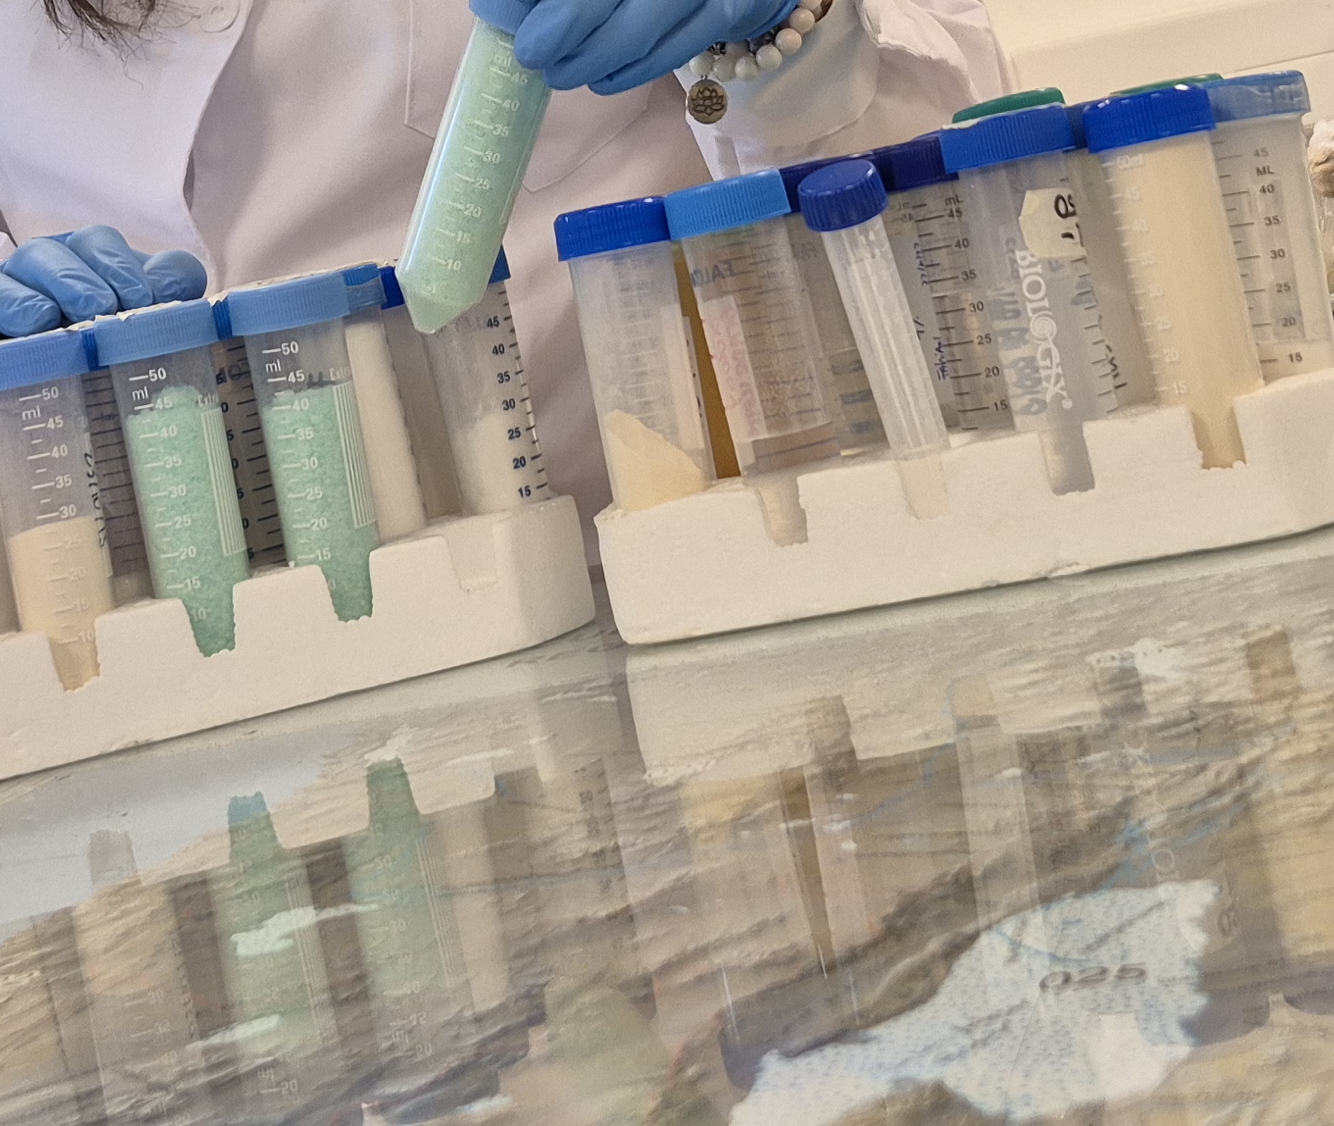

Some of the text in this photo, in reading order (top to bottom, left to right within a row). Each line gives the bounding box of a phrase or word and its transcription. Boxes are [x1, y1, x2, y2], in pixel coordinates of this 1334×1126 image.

[502, 100, 520, 111] 40
[492, 125, 509, 137] 35
[483, 151, 501, 163] 30
[1253, 147, 1268, 158] 45
[1256, 166, 1274, 176] ML
[473, 178, 491, 190] 25
[1259, 184, 1275, 194] 40
[945, 194, 963, 205] mL
[1125, 188, 1140, 201] 45
[464, 205, 481, 218] 20
[947, 207, 963, 219] 45
[1264, 215, 1280, 226] 35
[455, 232, 472, 244] 15
[954, 238, 970, 249] 40
[1270, 248, 1285, 259] 30
[447, 259, 462, 271] 10
[961, 269, 977, 281] 35
[1276, 282, 1291, 294] 25
[969, 301, 985, 313] 30
[486, 315, 500, 329] 45
[1282, 316, 1296, 327] 20
[977, 334, 993, 346] 25
[281, 341, 299, 356] 50
[492, 343, 505, 355] 40
[1289, 351, 1303, 363] 15
[265, 359, 282, 373] ml
[984, 366, 1000, 378] 20
[148, 367, 167, 382] 50
[287, 370, 305, 384] 45
[497, 371, 511, 384] 35
[42, 386, 59, 400] 50
[132, 386, 149, 401] ml
[1172, 380, 1187, 394] 15
[154, 395, 173, 409] 45
[292, 398, 310, 412] 40
[502, 398, 516, 411] 30
[994, 401, 1009, 413] 15
[22, 405, 41, 421] ml
[47, 415, 64, 430] 45
[160, 424, 178, 438] 40
[296, 427, 314, 441] 35
[507, 427, 522, 440] 25
[51, 444, 68, 459] 40
[164, 453, 182, 468] 35
[302, 457, 318, 470] 30
[512, 456, 527, 469] 20
[55, 474, 72, 489] 35
[169, 484, 187, 499] 30
[306, 486, 323, 501] 25
[518, 485, 532, 498] 15
[59, 504, 77, 518] 30
[174, 515, 191, 529] 25
[310, 517, 328, 531] 20
[179, 545, 197, 560] 20
[316, 548, 332, 561] 15
[184, 577, 201, 591] 15
[78, 630, 94, 643] 10
